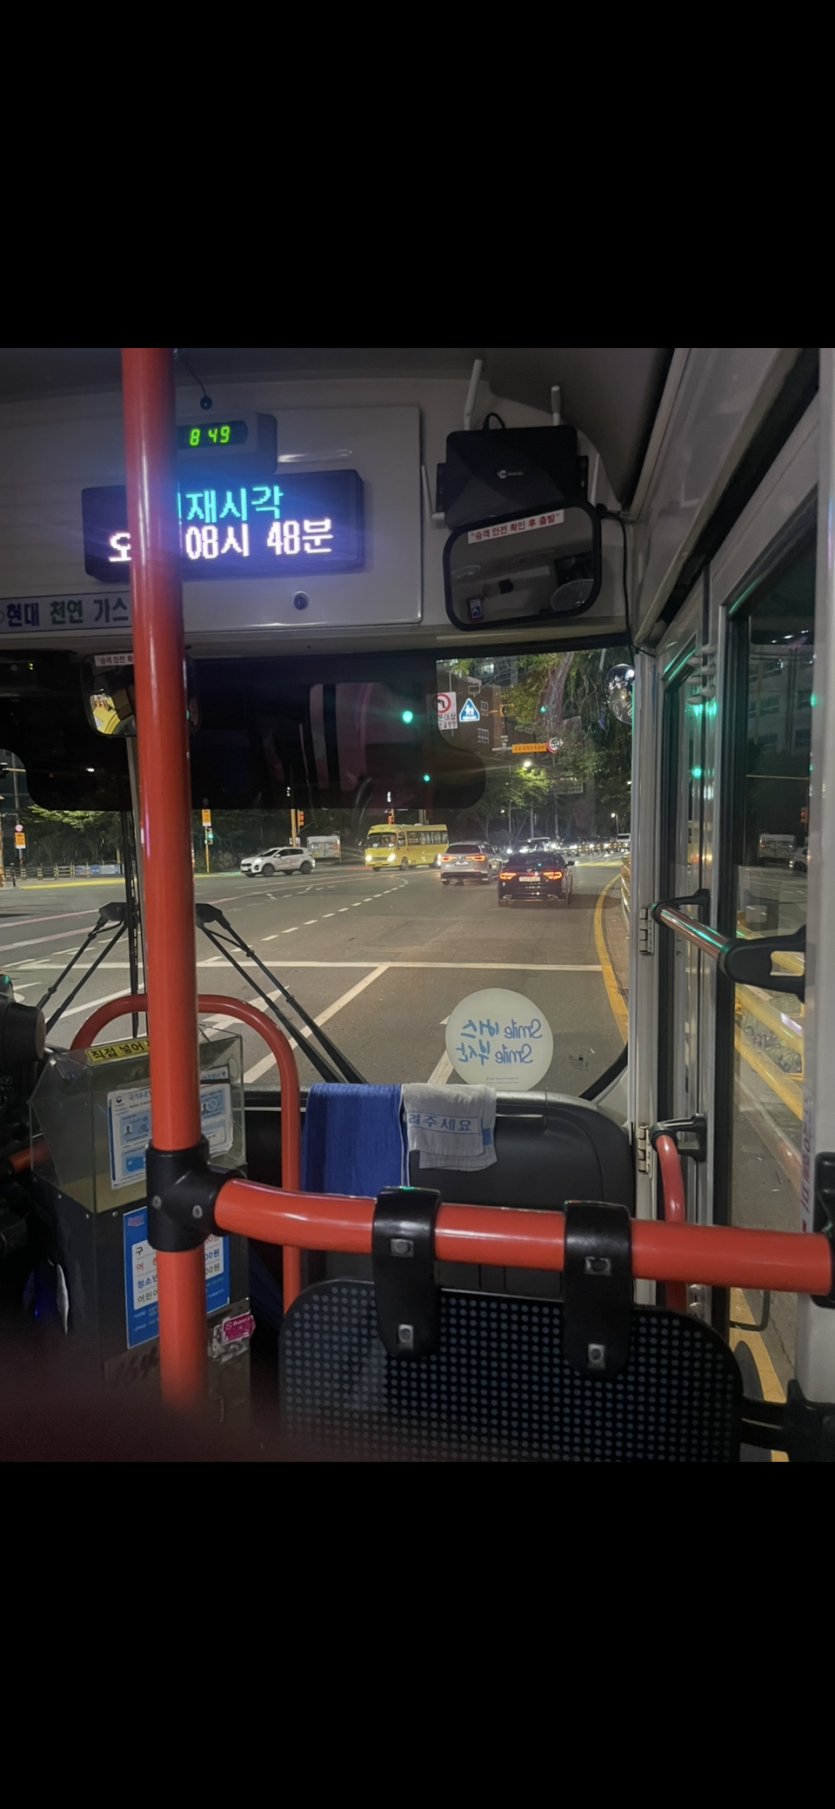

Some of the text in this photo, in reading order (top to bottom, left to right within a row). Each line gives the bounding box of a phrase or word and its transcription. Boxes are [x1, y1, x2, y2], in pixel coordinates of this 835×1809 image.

[189, 425, 231, 446] 8 49
[177, 485, 284, 523] 재시각
[492, 525, 507, 536] 안전
[510, 521, 525, 532] 확인
[528, 518, 536, 528] 후
[109, 518, 334, 562] 오 08시 48분
[6, 597, 129, 628] 현대 천연 가스
[91, 1047, 118, 1060] 직접
[119, 1041, 145, 1055] 넣어
[128, 1090, 151, 1101] 국가유공
[408, 1113, 471, 1132] 려주세요
[204, 1249, 220, 1261] 00원
[205, 1263, 220, 1275] 00원
